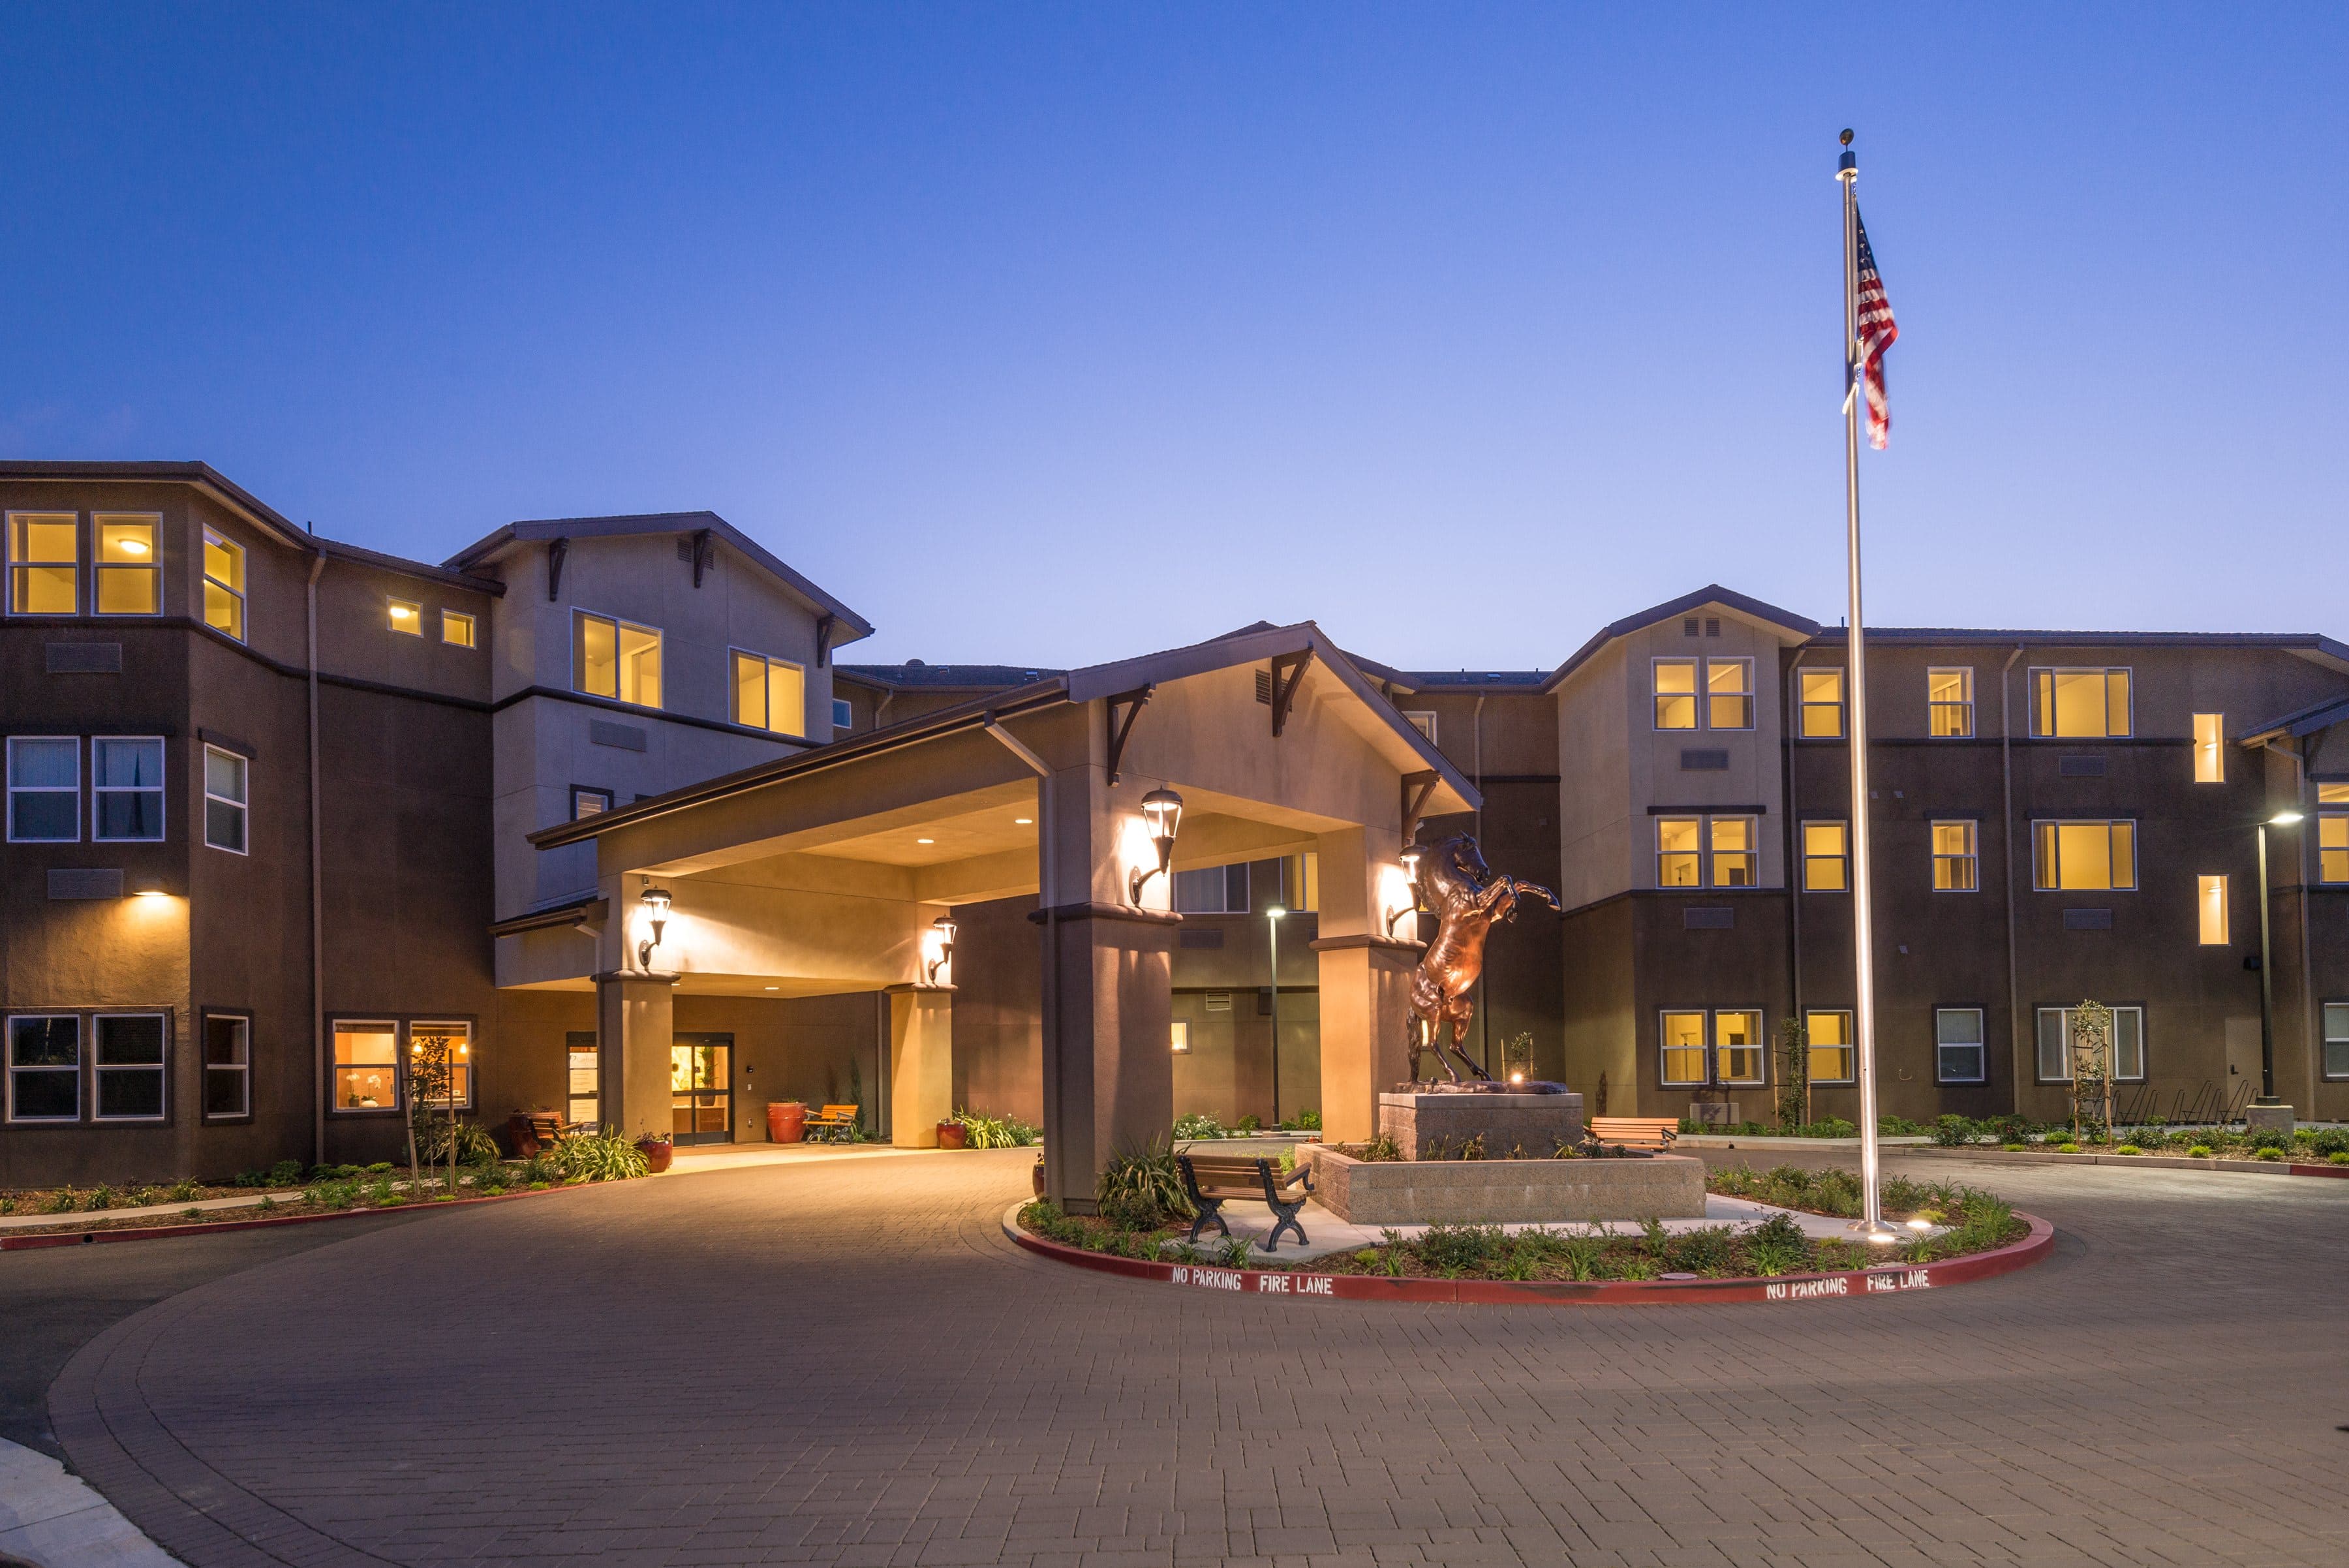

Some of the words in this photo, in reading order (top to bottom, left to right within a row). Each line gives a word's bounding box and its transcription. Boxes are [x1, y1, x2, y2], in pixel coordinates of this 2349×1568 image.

[1173, 1267, 1188, 1284] NO
[1193, 1268, 1242, 1290] PARKING
[1260, 1274, 1290, 1293] FIRE
[1297, 1276, 1333, 1295] LANE
[1766, 1283, 1786, 1299] NO
[1792, 1277, 1847, 1297] PARKING
[1867, 1274, 1896, 1291] FIRE
[1900, 1269, 1930, 1289] LANE
